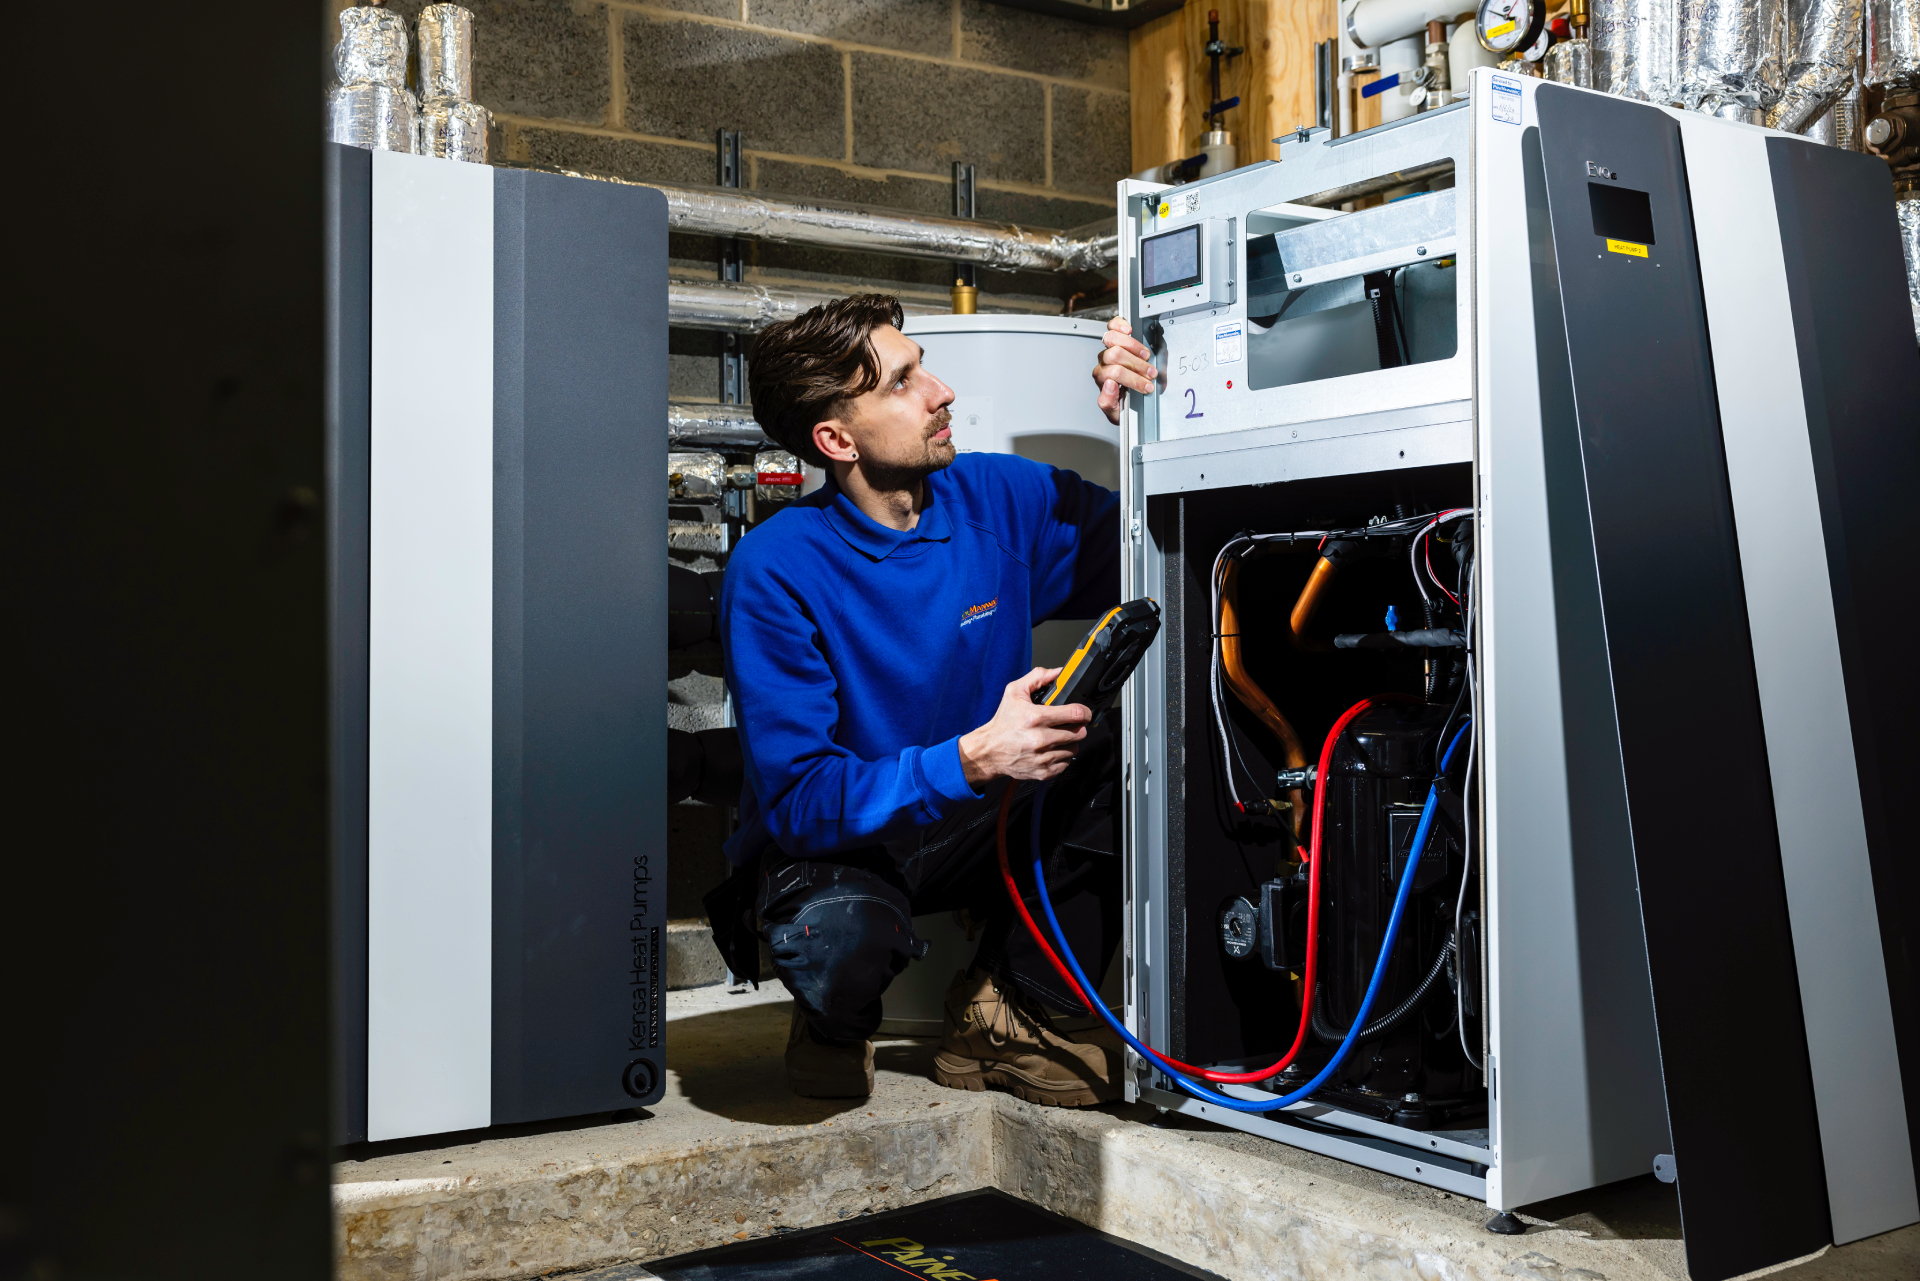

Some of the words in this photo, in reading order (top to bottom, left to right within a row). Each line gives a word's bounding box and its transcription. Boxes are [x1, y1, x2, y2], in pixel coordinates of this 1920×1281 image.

[1184, 387, 1205, 419] 2
[630, 854, 652, 931] Pumps
[629, 933, 648, 985] Heat
[628, 987, 647, 1051] Kensa
[650, 1009, 658, 1037] KENSA
